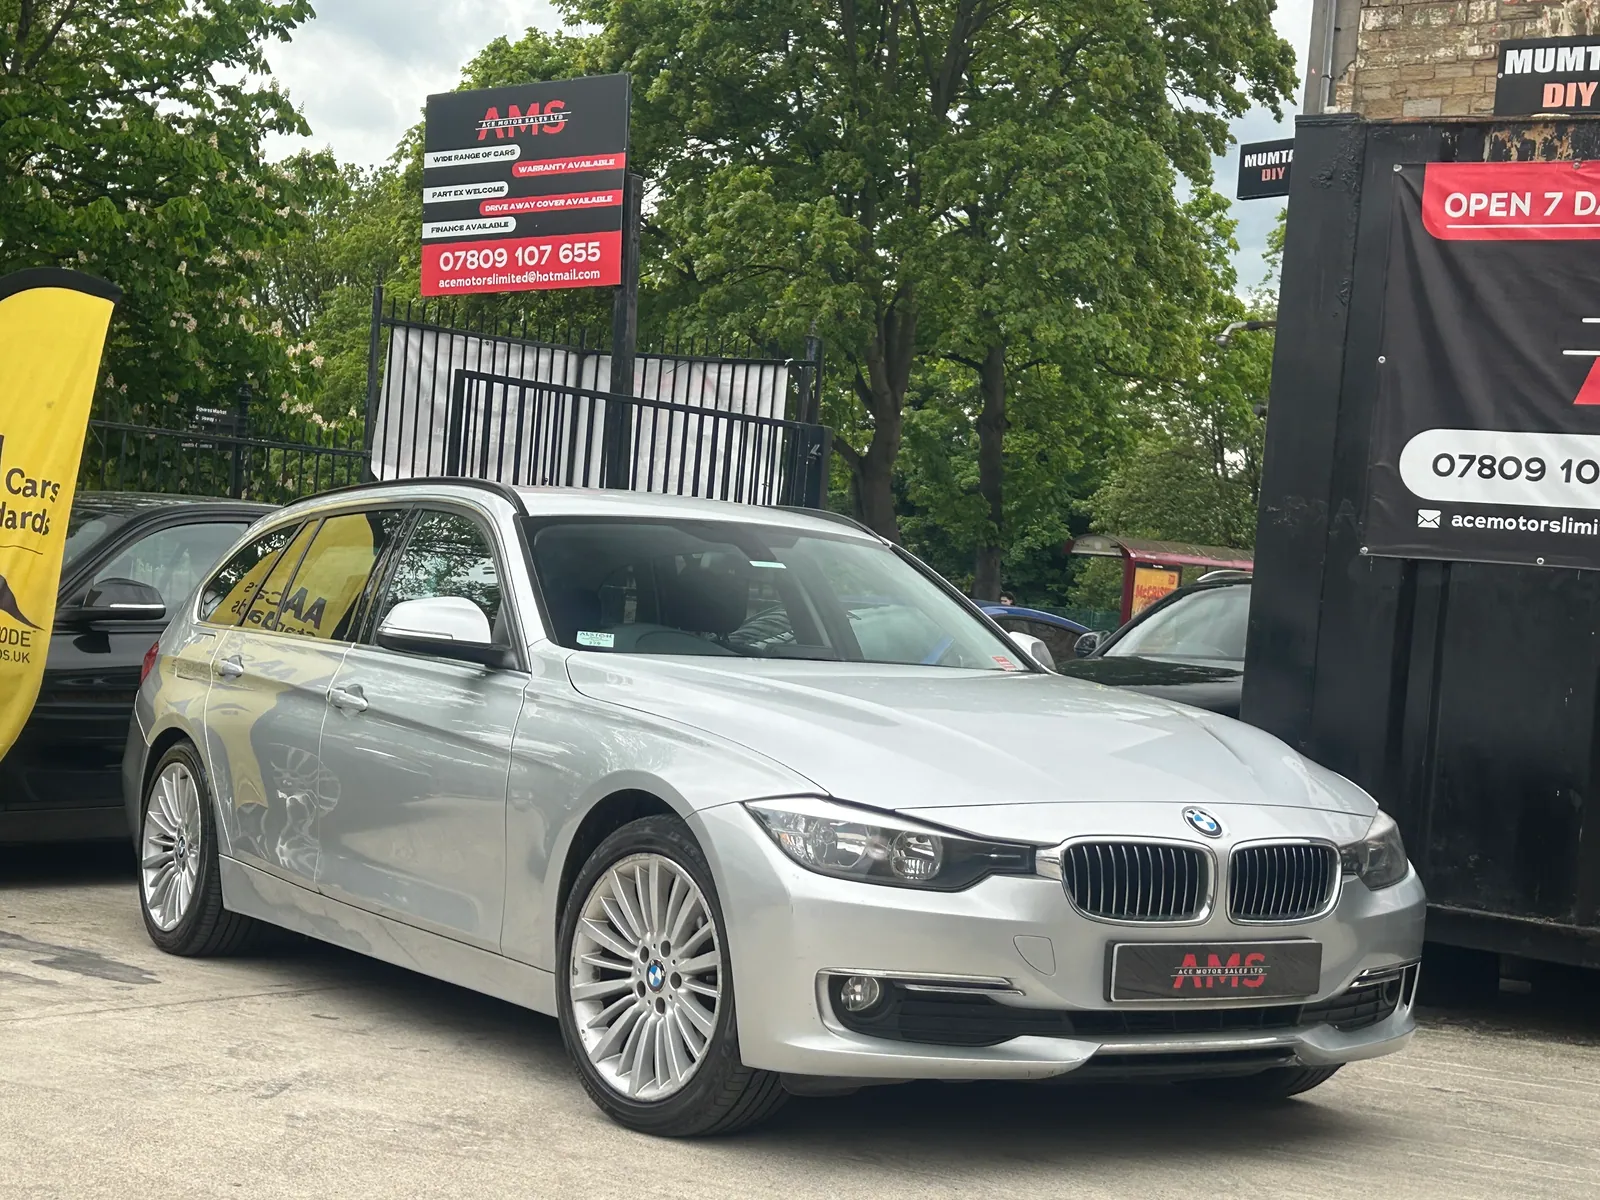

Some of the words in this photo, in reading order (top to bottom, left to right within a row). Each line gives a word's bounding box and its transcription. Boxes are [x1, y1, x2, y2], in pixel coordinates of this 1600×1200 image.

[1505, 46, 1600, 74] MUMT
[1542, 82, 1598, 107] DIY
[477, 100, 565, 140] AMS
[525, 116, 547, 124] SALES
[433, 155, 453, 163] WIDE
[454, 152, 480, 161] RANGE
[493, 149, 516, 157] CARS
[518, 162, 566, 173] WARRANTY
[567, 159, 615, 169] AVAILABLE
[1261, 167, 1285, 181] DIY
[432, 190, 452, 198] PART
[465, 186, 505, 195] WELCOME
[485, 203, 508, 212] DRIVE
[509, 201, 537, 210] AWAY
[537, 198, 565, 208] COVER
[566, 195, 613, 206] AVAILABLE
[1444, 192, 1532, 218] OPEN
[1543, 192, 1563, 216] 7
[1574, 191, 1600, 216] D
[431, 225, 464, 233] FINANCE
[465, 221, 509, 231] AVAILABLE
[439, 248, 508, 271] 07809
[515, 245, 552, 266] 107
[559, 242, 600, 264] 655
[438, 269, 600, 288] acemotorslimited@hotmail.com
[1432, 453, 1546, 482] 07809
[1560, 458, 1600, 484] 10
[5, 467, 60, 503] Cars
[1173, 952, 1265, 988] AMS
